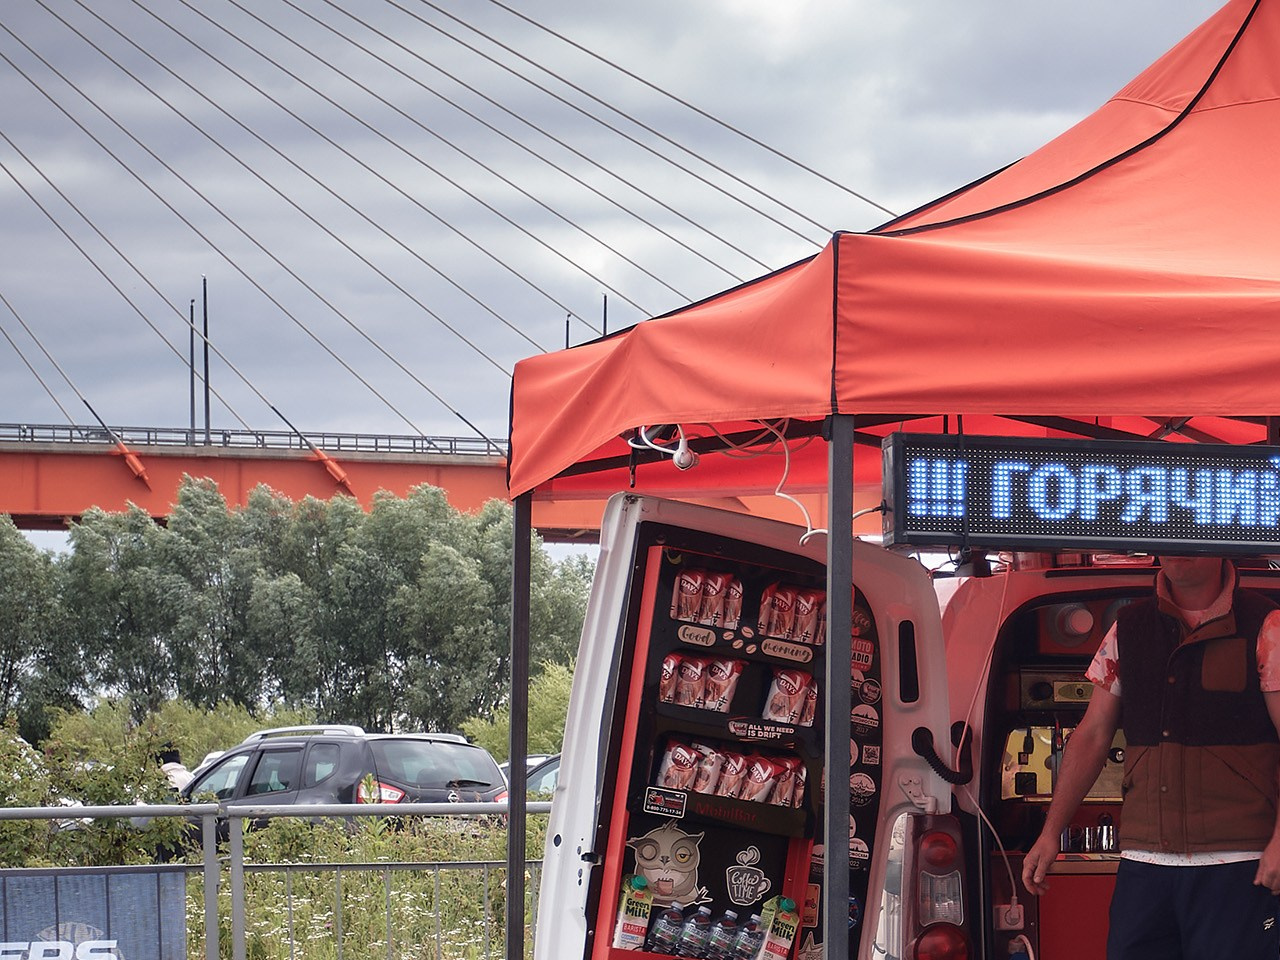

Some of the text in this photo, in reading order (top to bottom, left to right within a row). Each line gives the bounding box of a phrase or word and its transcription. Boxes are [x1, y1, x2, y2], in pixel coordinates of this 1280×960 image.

[680, 579, 698, 595] DAYS
[682, 626, 711, 645] Good
[852, 652, 870, 664] ADIO
[779, 680, 797, 695] DAYS
[757, 731, 782, 739] DRIFT
[776, 727, 795, 735] NEED
[674, 752, 692, 769] DAYS
[732, 871, 760, 886] Coffee
[732, 885, 755, 899] TIME
[626, 898, 650, 911] Green
[625, 905, 649, 919] Milk
[623, 923, 647, 935] BARISTA
[773, 917, 795, 933] Green
[771, 924, 794, 941] Milk
[766, 941, 788, 955] BARISTA
